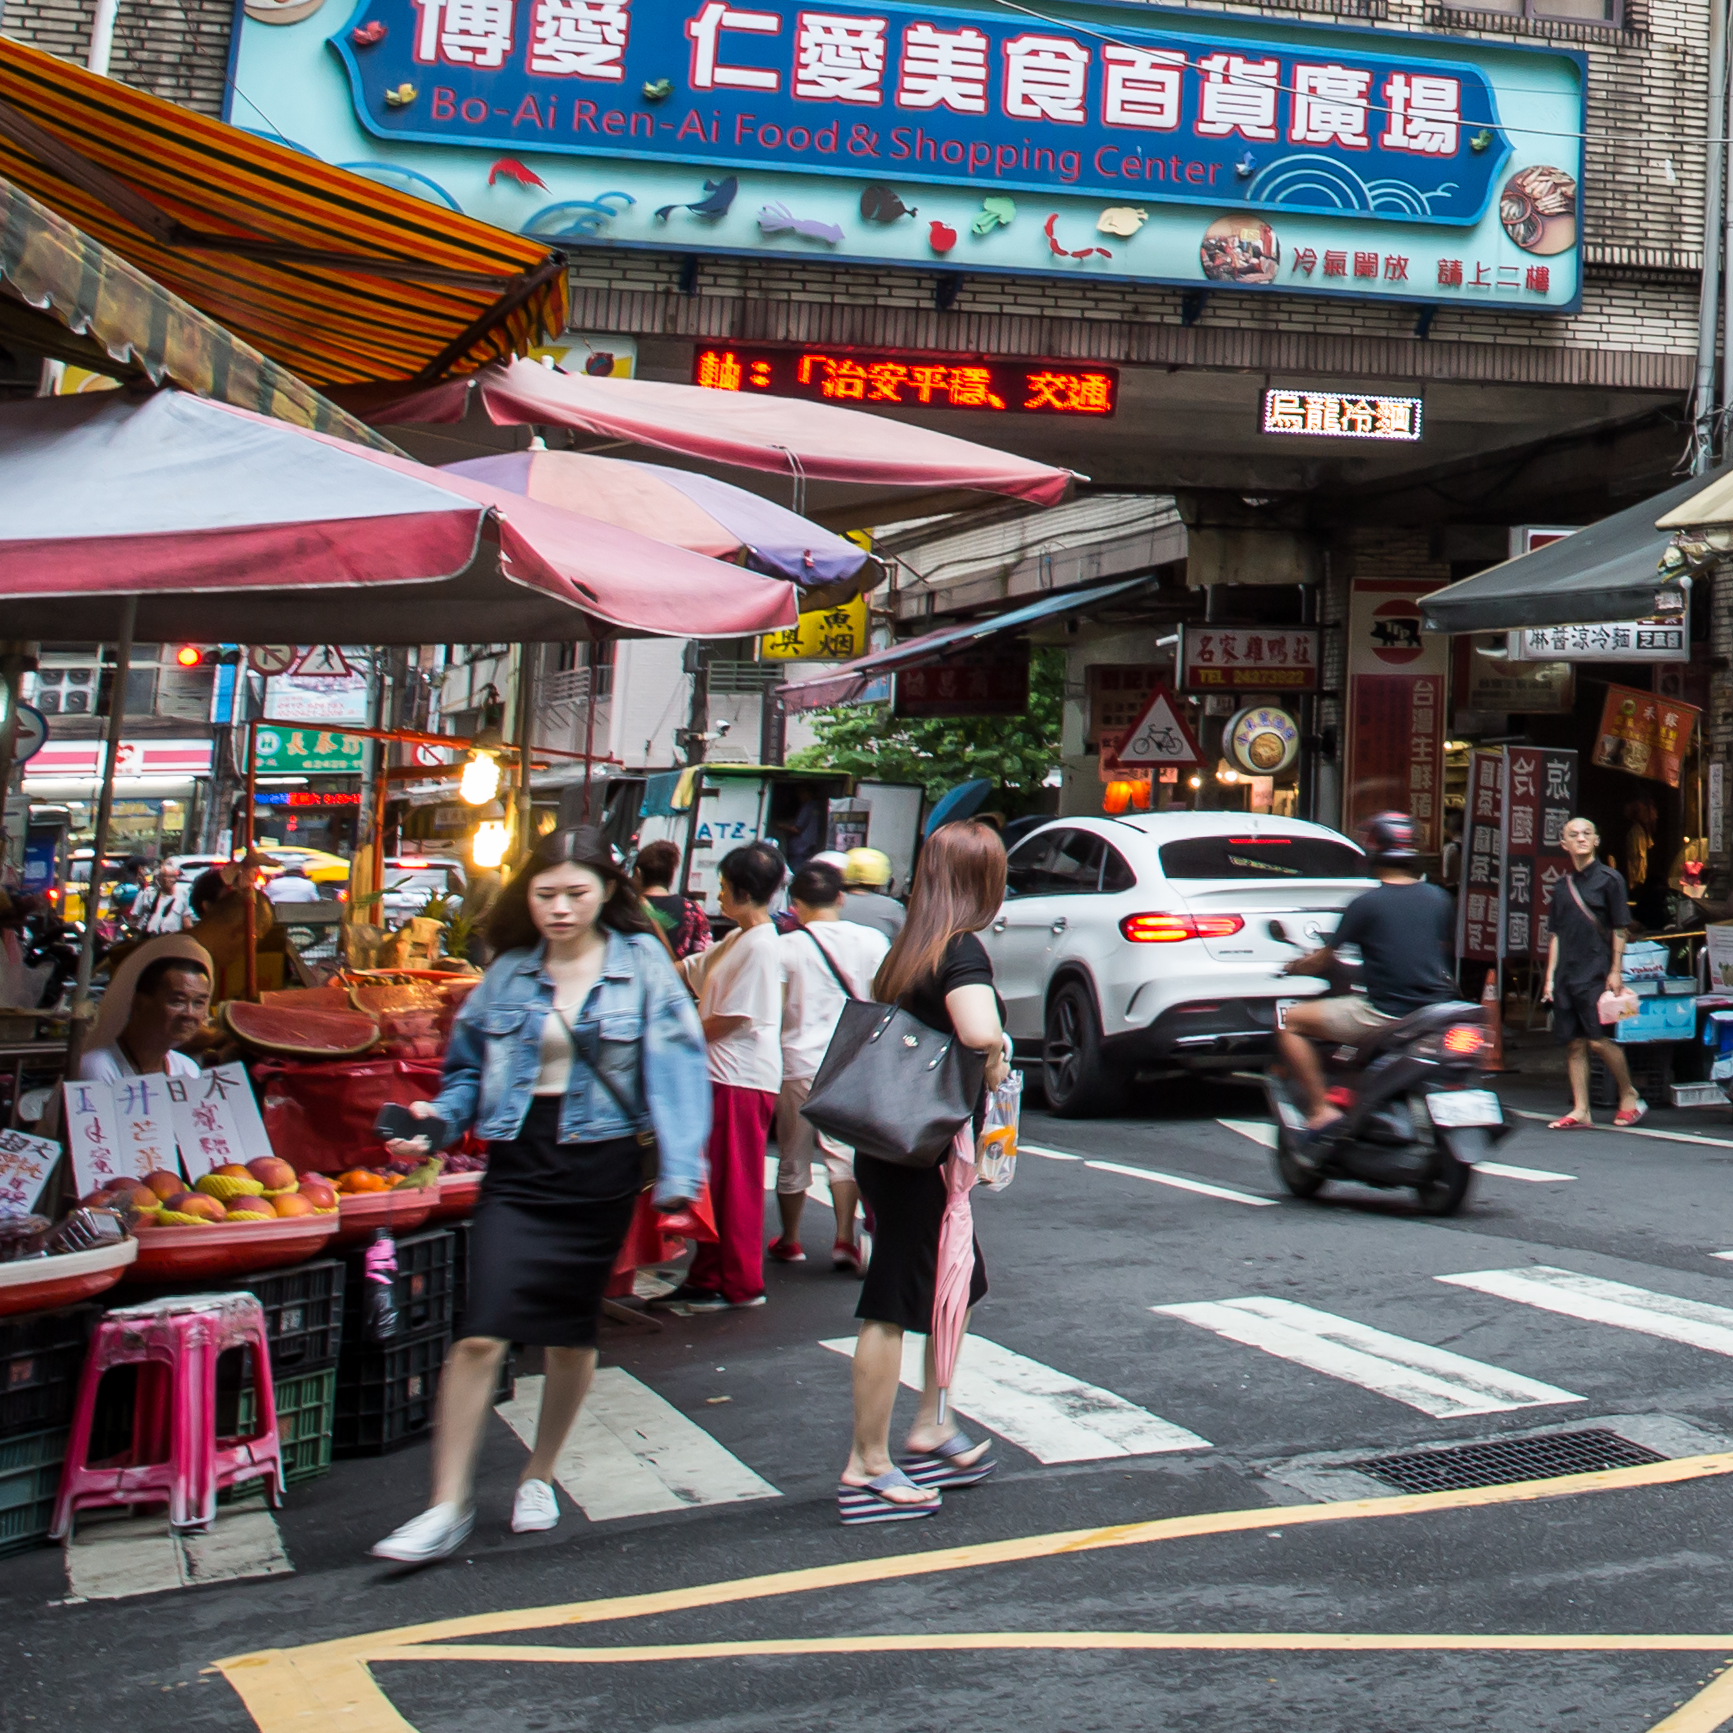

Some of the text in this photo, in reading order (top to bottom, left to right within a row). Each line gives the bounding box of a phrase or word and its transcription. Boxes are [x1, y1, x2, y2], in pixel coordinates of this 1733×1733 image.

[431, 86, 1222, 186] Bo-Ai Ren-Ai Food & Shopping Center
[1292, 245, 1551, 293] 冷氣開放 請上二樓
[1199, 669, 1227, 685] TEL
[166, 1069, 240, 1102] 日本
